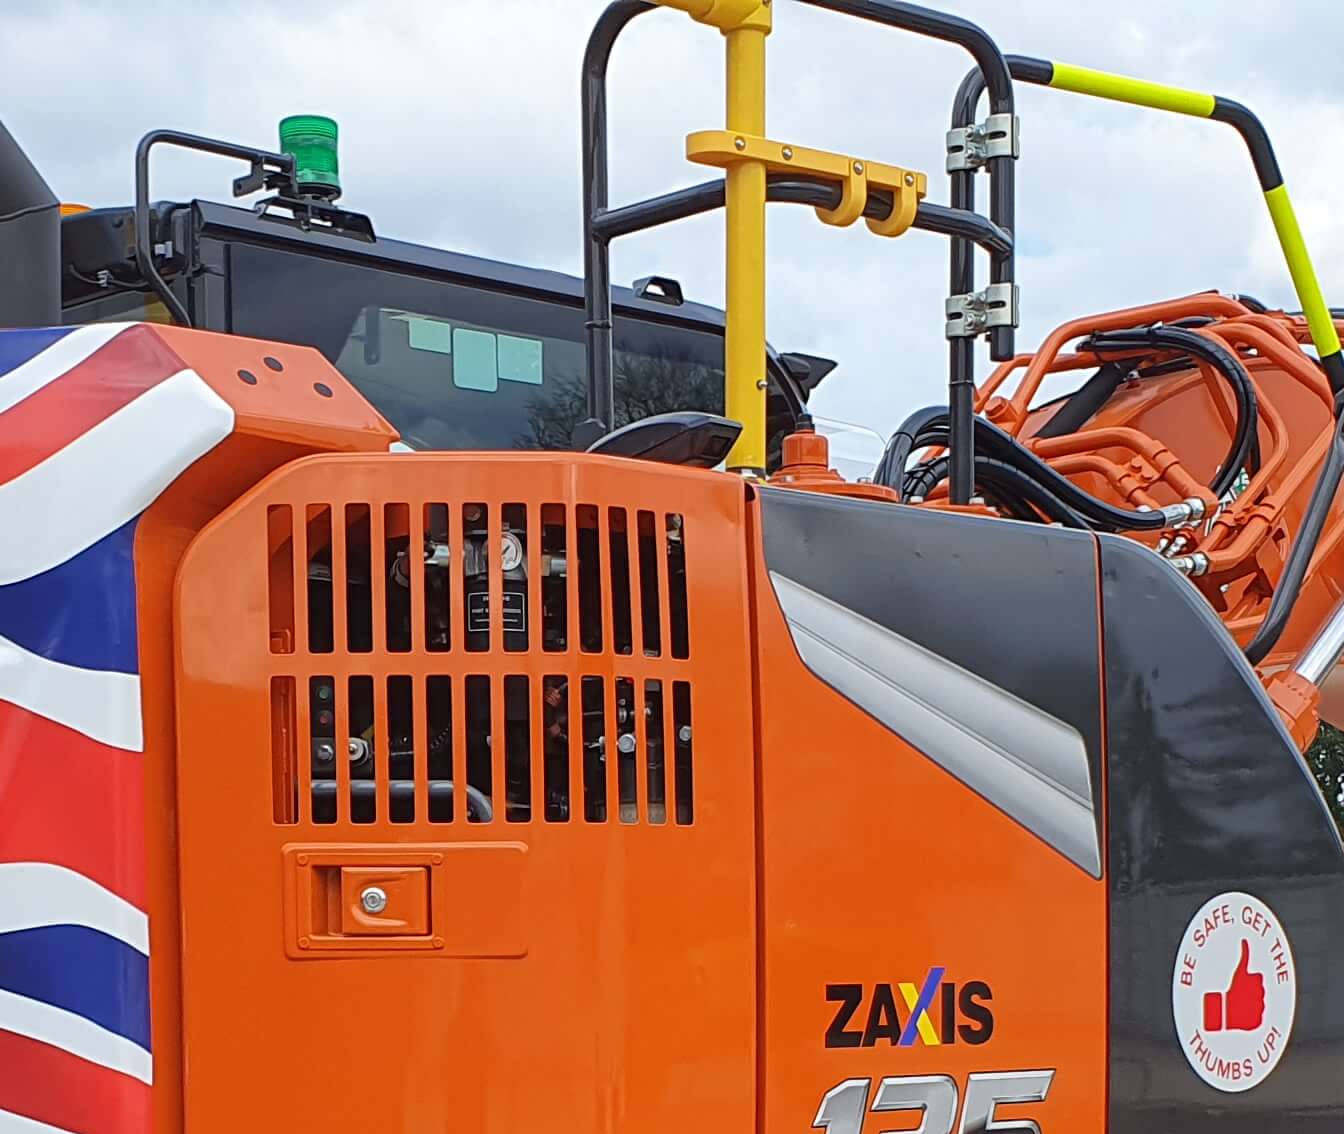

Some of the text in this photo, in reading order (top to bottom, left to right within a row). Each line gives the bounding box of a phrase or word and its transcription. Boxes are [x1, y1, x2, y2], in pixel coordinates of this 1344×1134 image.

[1180, 904, 1289, 987] BE SAFE, GET THE
[824, 967, 994, 1049] ZAXIS
[1189, 1026, 1283, 1080] THUMBS UP!
